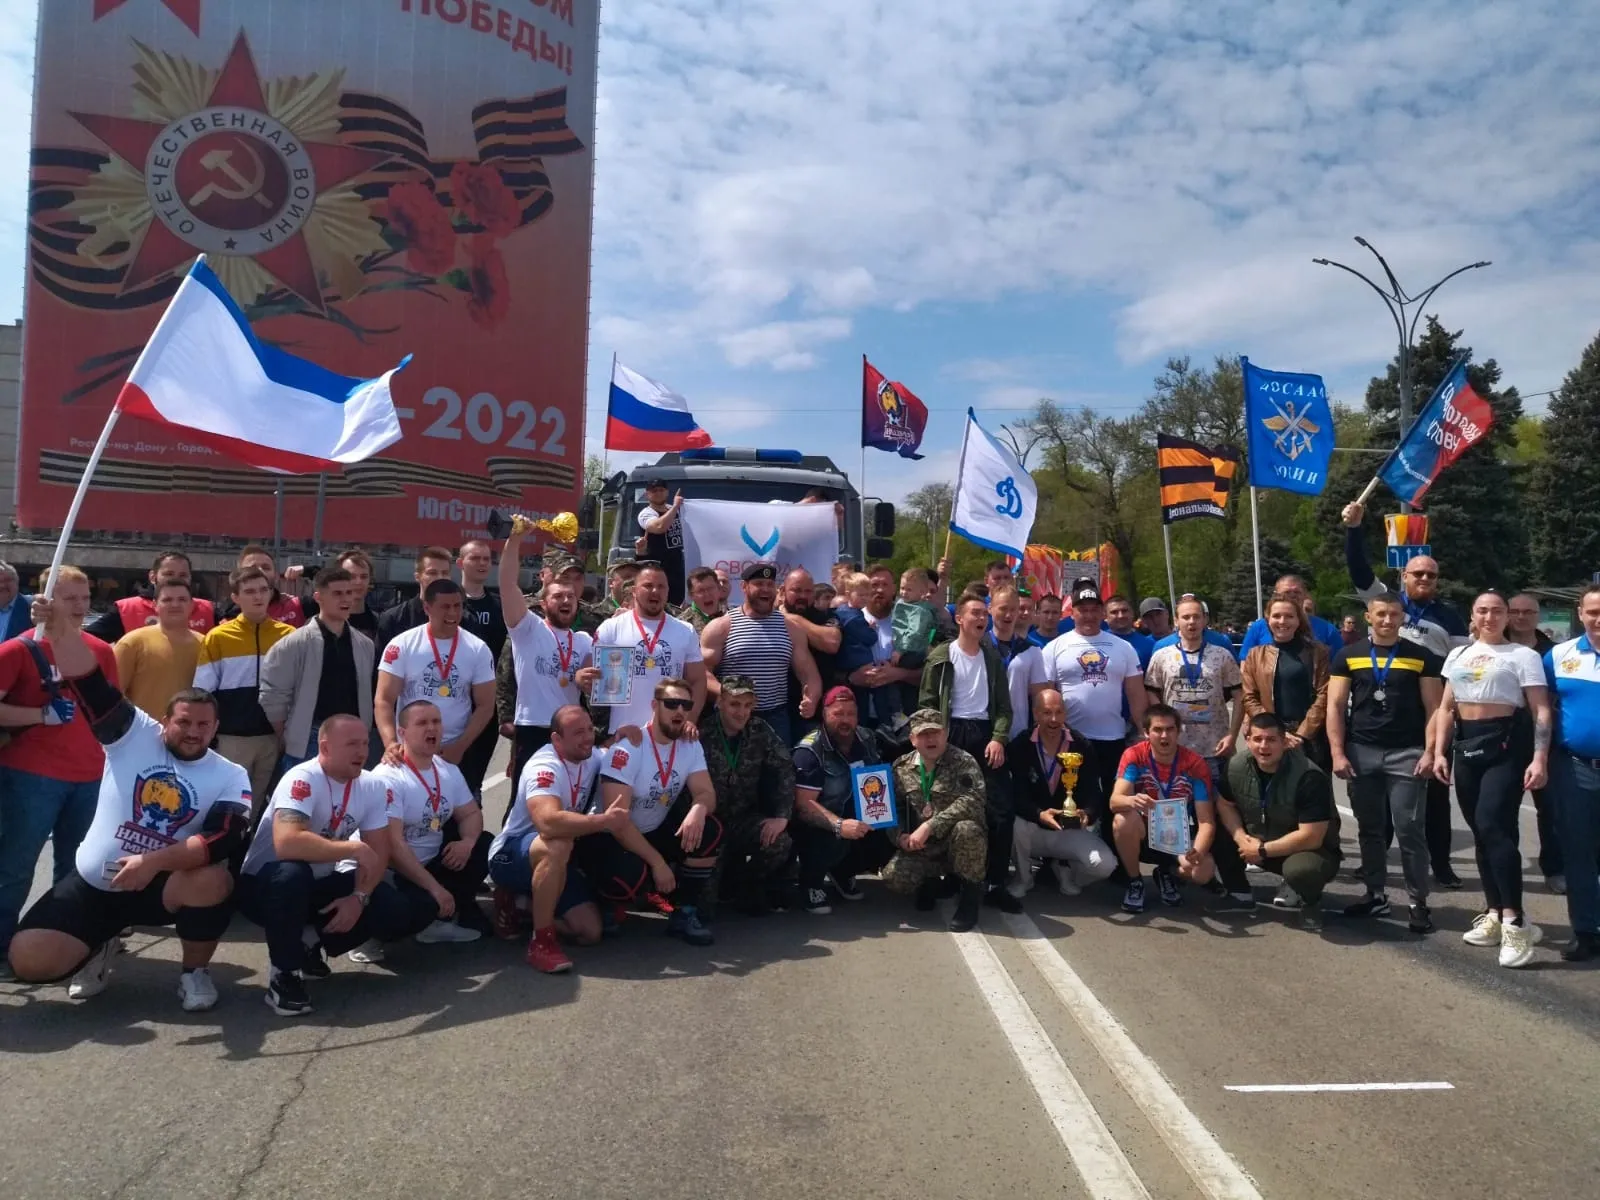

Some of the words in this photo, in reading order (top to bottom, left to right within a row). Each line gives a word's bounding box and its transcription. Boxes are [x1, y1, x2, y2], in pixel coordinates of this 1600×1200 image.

[152, 113, 298, 234] ОТЕЧЕСТВЕННАЯ
[70, 437, 168, 455] Росв-на-Дону
[715, 560, 805, 577] СВООД
